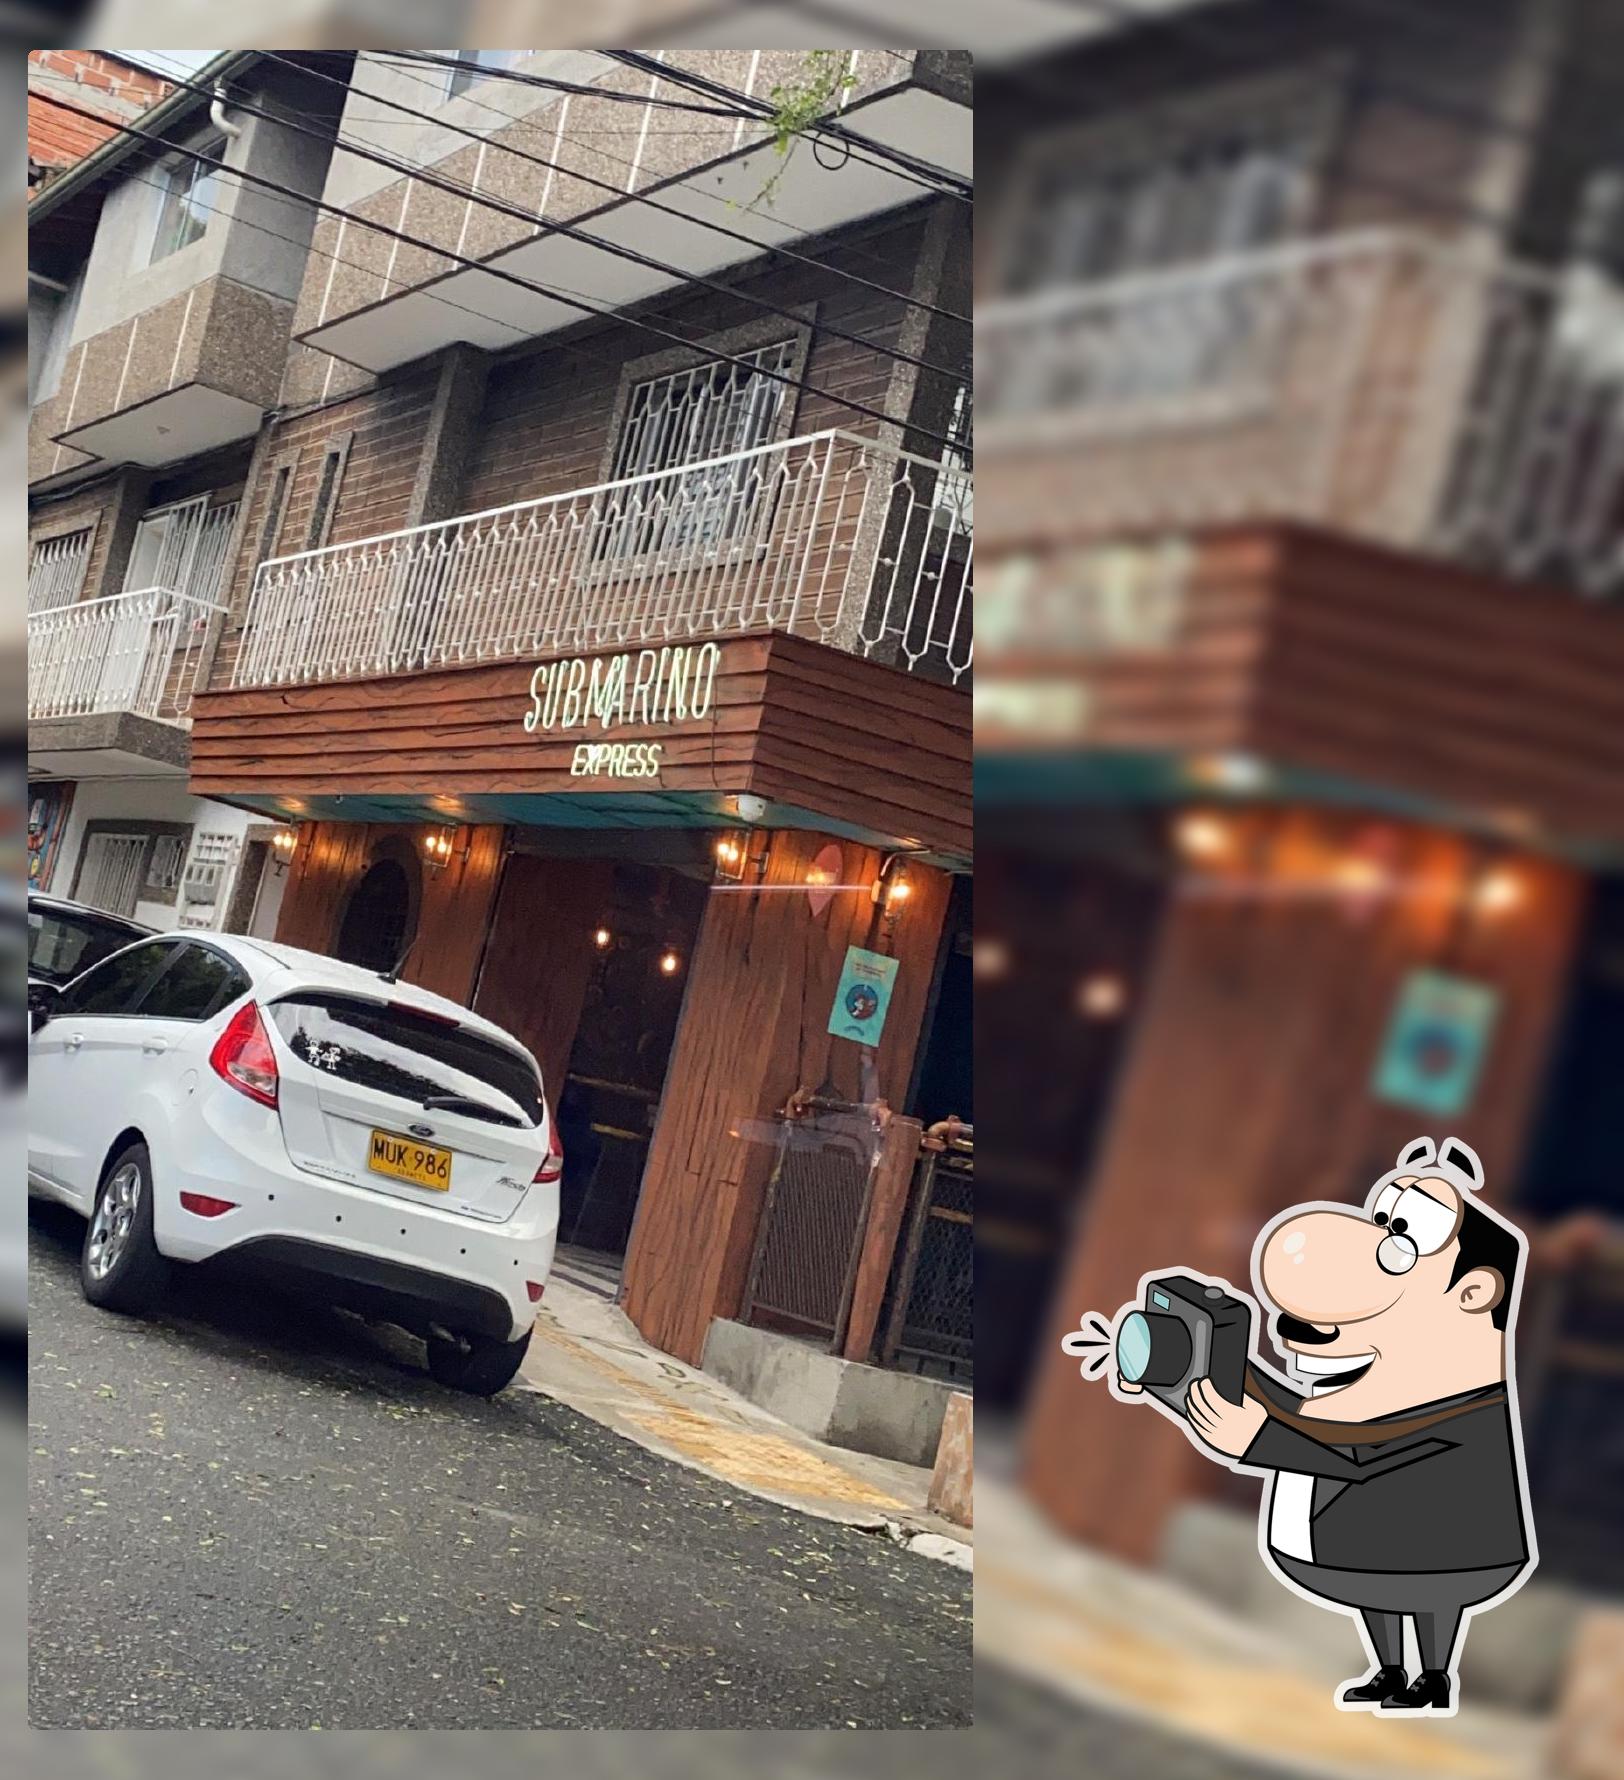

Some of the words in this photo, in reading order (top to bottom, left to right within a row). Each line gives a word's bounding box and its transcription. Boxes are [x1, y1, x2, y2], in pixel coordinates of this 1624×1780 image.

[523, 642, 721, 733] SUBMARINO
[570, 743, 662, 778] EXPRESS
[373, 1138, 408, 1168] MUK
[413, 1150, 448, 1178] 986
